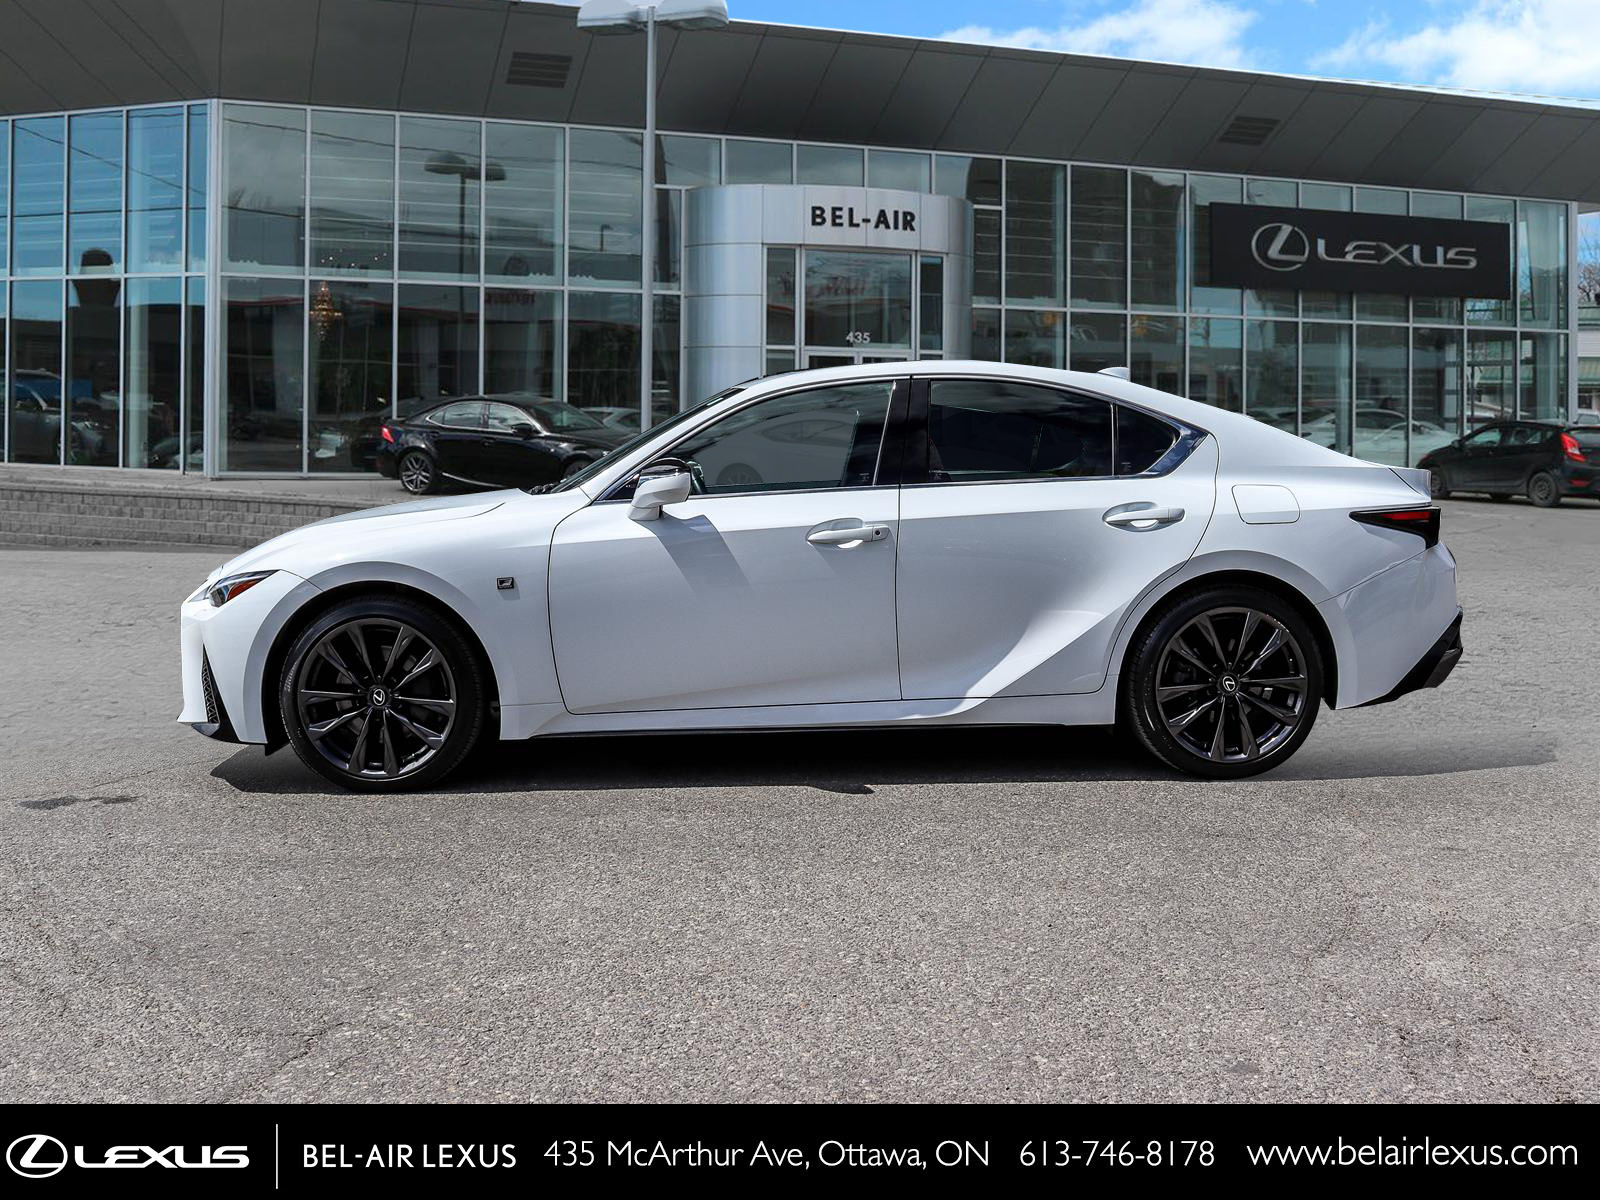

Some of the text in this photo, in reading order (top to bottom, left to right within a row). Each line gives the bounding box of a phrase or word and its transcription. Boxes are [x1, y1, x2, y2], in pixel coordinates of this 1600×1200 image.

[811, 206, 916, 232] BEL-AIR
[1317, 237, 1477, 270] LEXUS
[846, 331, 870, 344] 435
